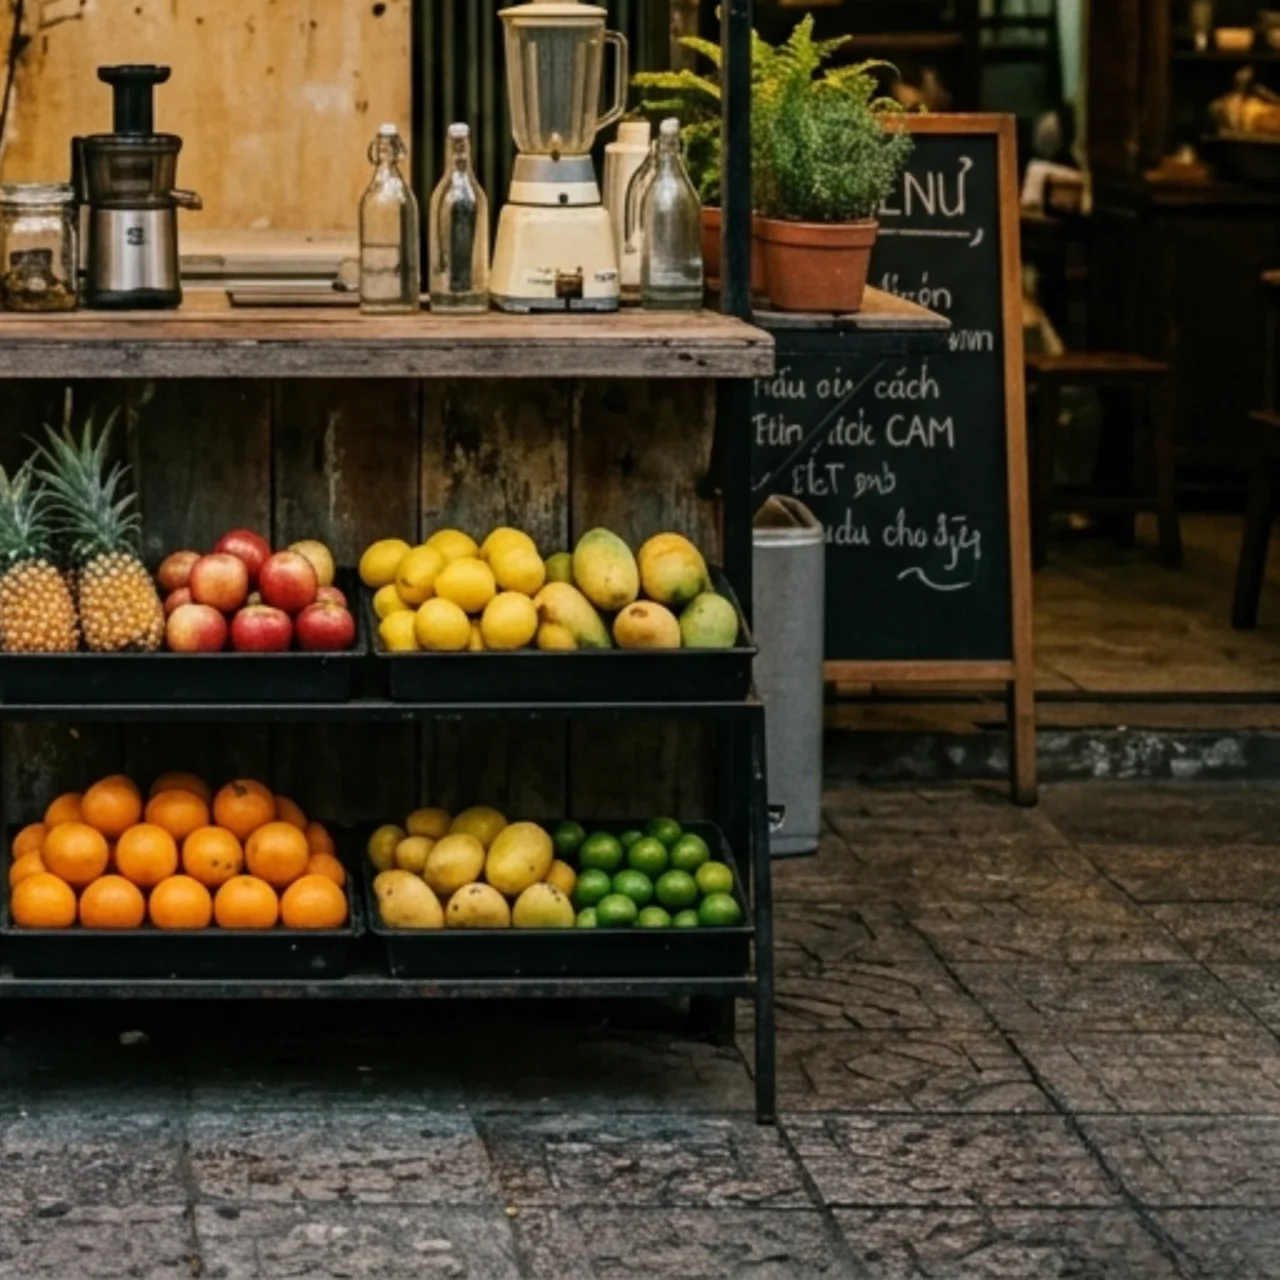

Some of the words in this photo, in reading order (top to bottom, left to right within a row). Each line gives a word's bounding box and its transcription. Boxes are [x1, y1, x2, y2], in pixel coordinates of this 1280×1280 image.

[873, 363, 941, 400] cách
[885, 413, 955, 448] CAM
[882, 507, 928, 548] cho
